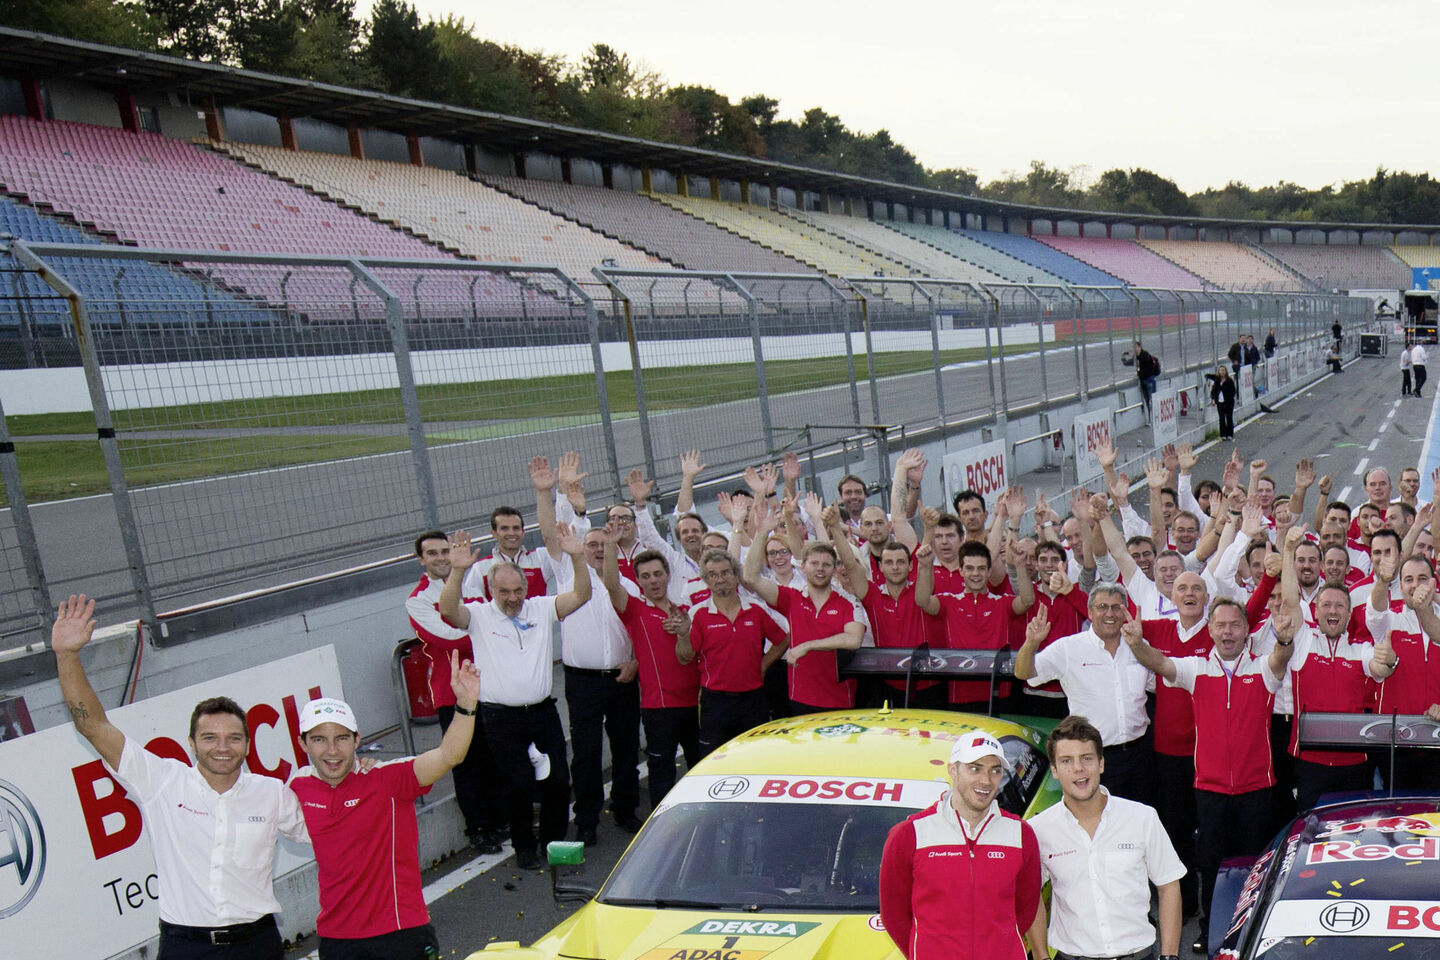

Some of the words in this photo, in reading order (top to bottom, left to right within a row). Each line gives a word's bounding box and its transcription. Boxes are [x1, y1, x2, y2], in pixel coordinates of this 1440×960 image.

[1159, 392, 1175, 423] BOSCH
[966, 453, 1005, 497] BOSCH
[758, 779, 903, 801] BOSCH
[1306, 838, 1440, 865] Red
[699, 921, 796, 936] DEKRA
[721, 936, 739, 949] 1
